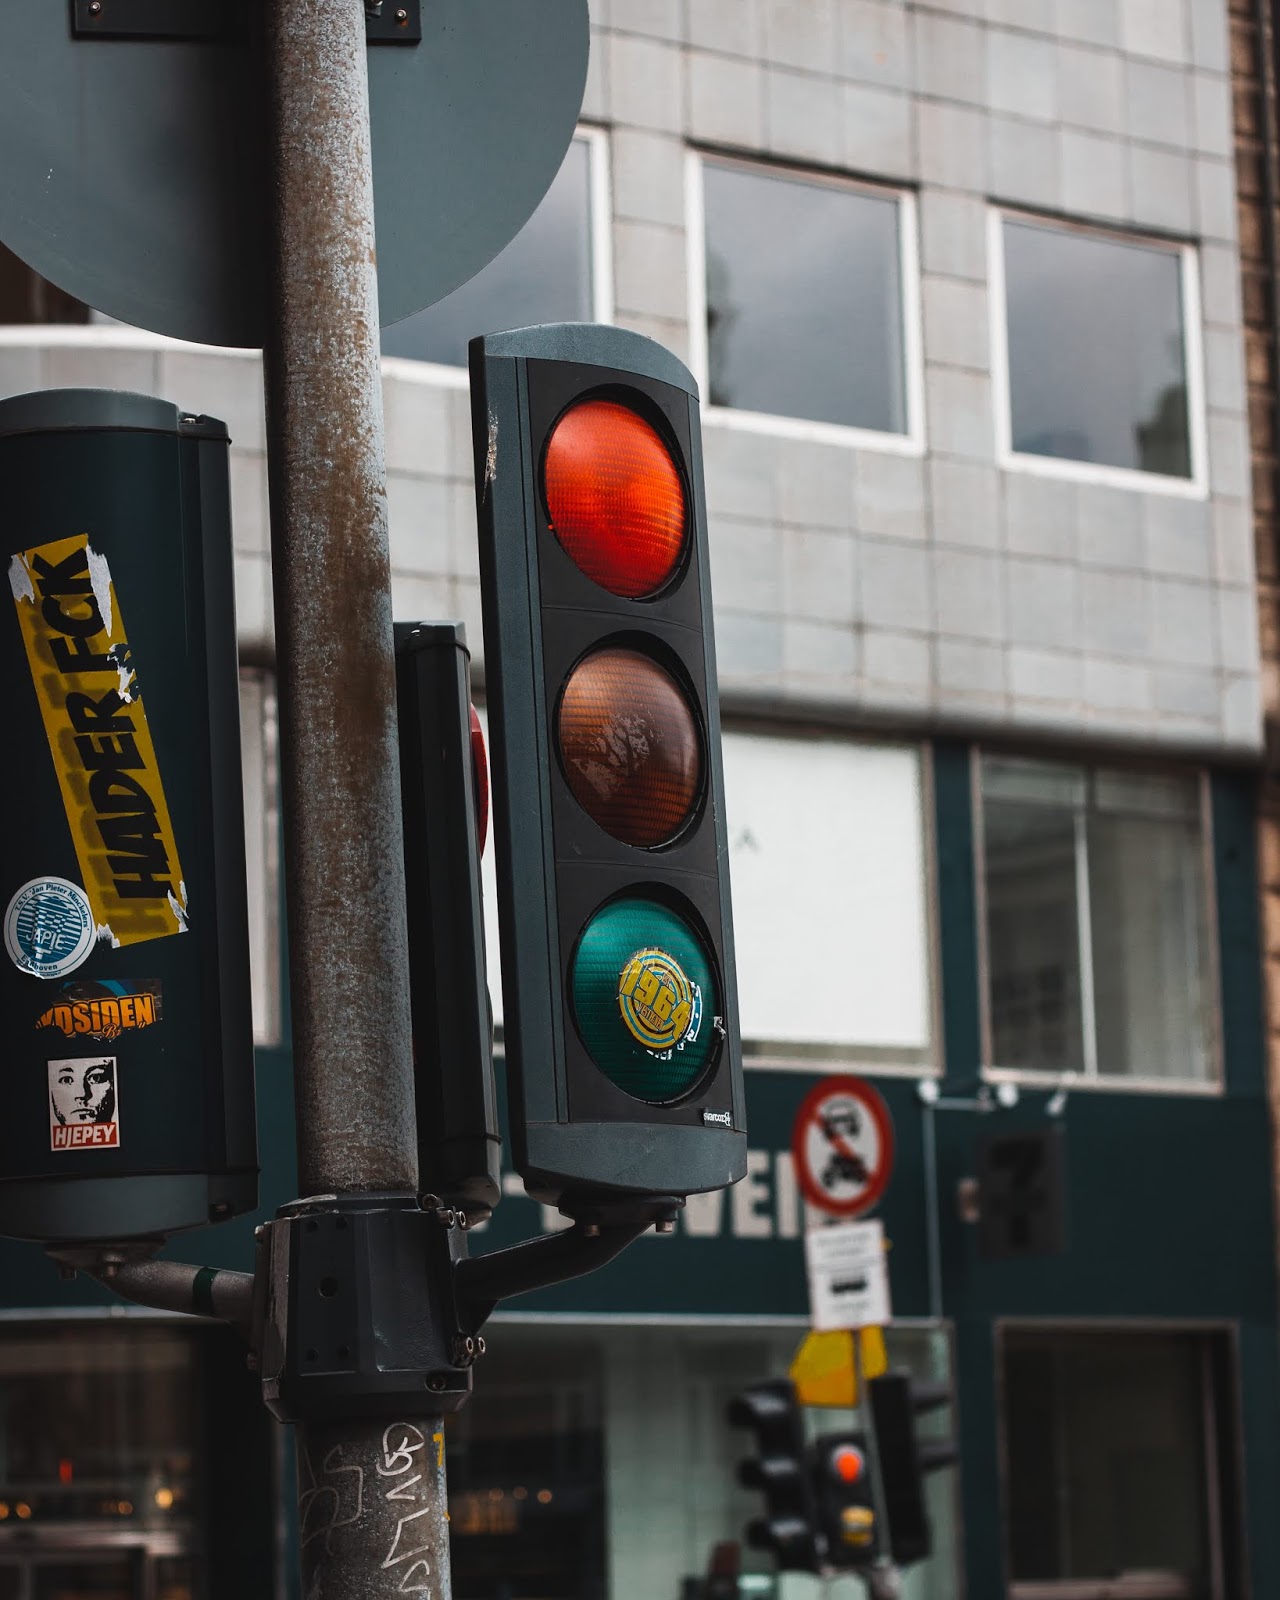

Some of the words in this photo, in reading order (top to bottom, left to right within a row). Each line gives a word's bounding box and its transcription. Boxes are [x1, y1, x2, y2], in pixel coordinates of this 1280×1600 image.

[32, 547, 122, 674] FCK
[66, 688, 178, 901] HADER
[45, 884, 67, 894] Pieter
[25, 927, 68, 951] JAPIE
[618, 958, 692, 1041] 1964
[55, 1124, 116, 1148] HJEPEY
